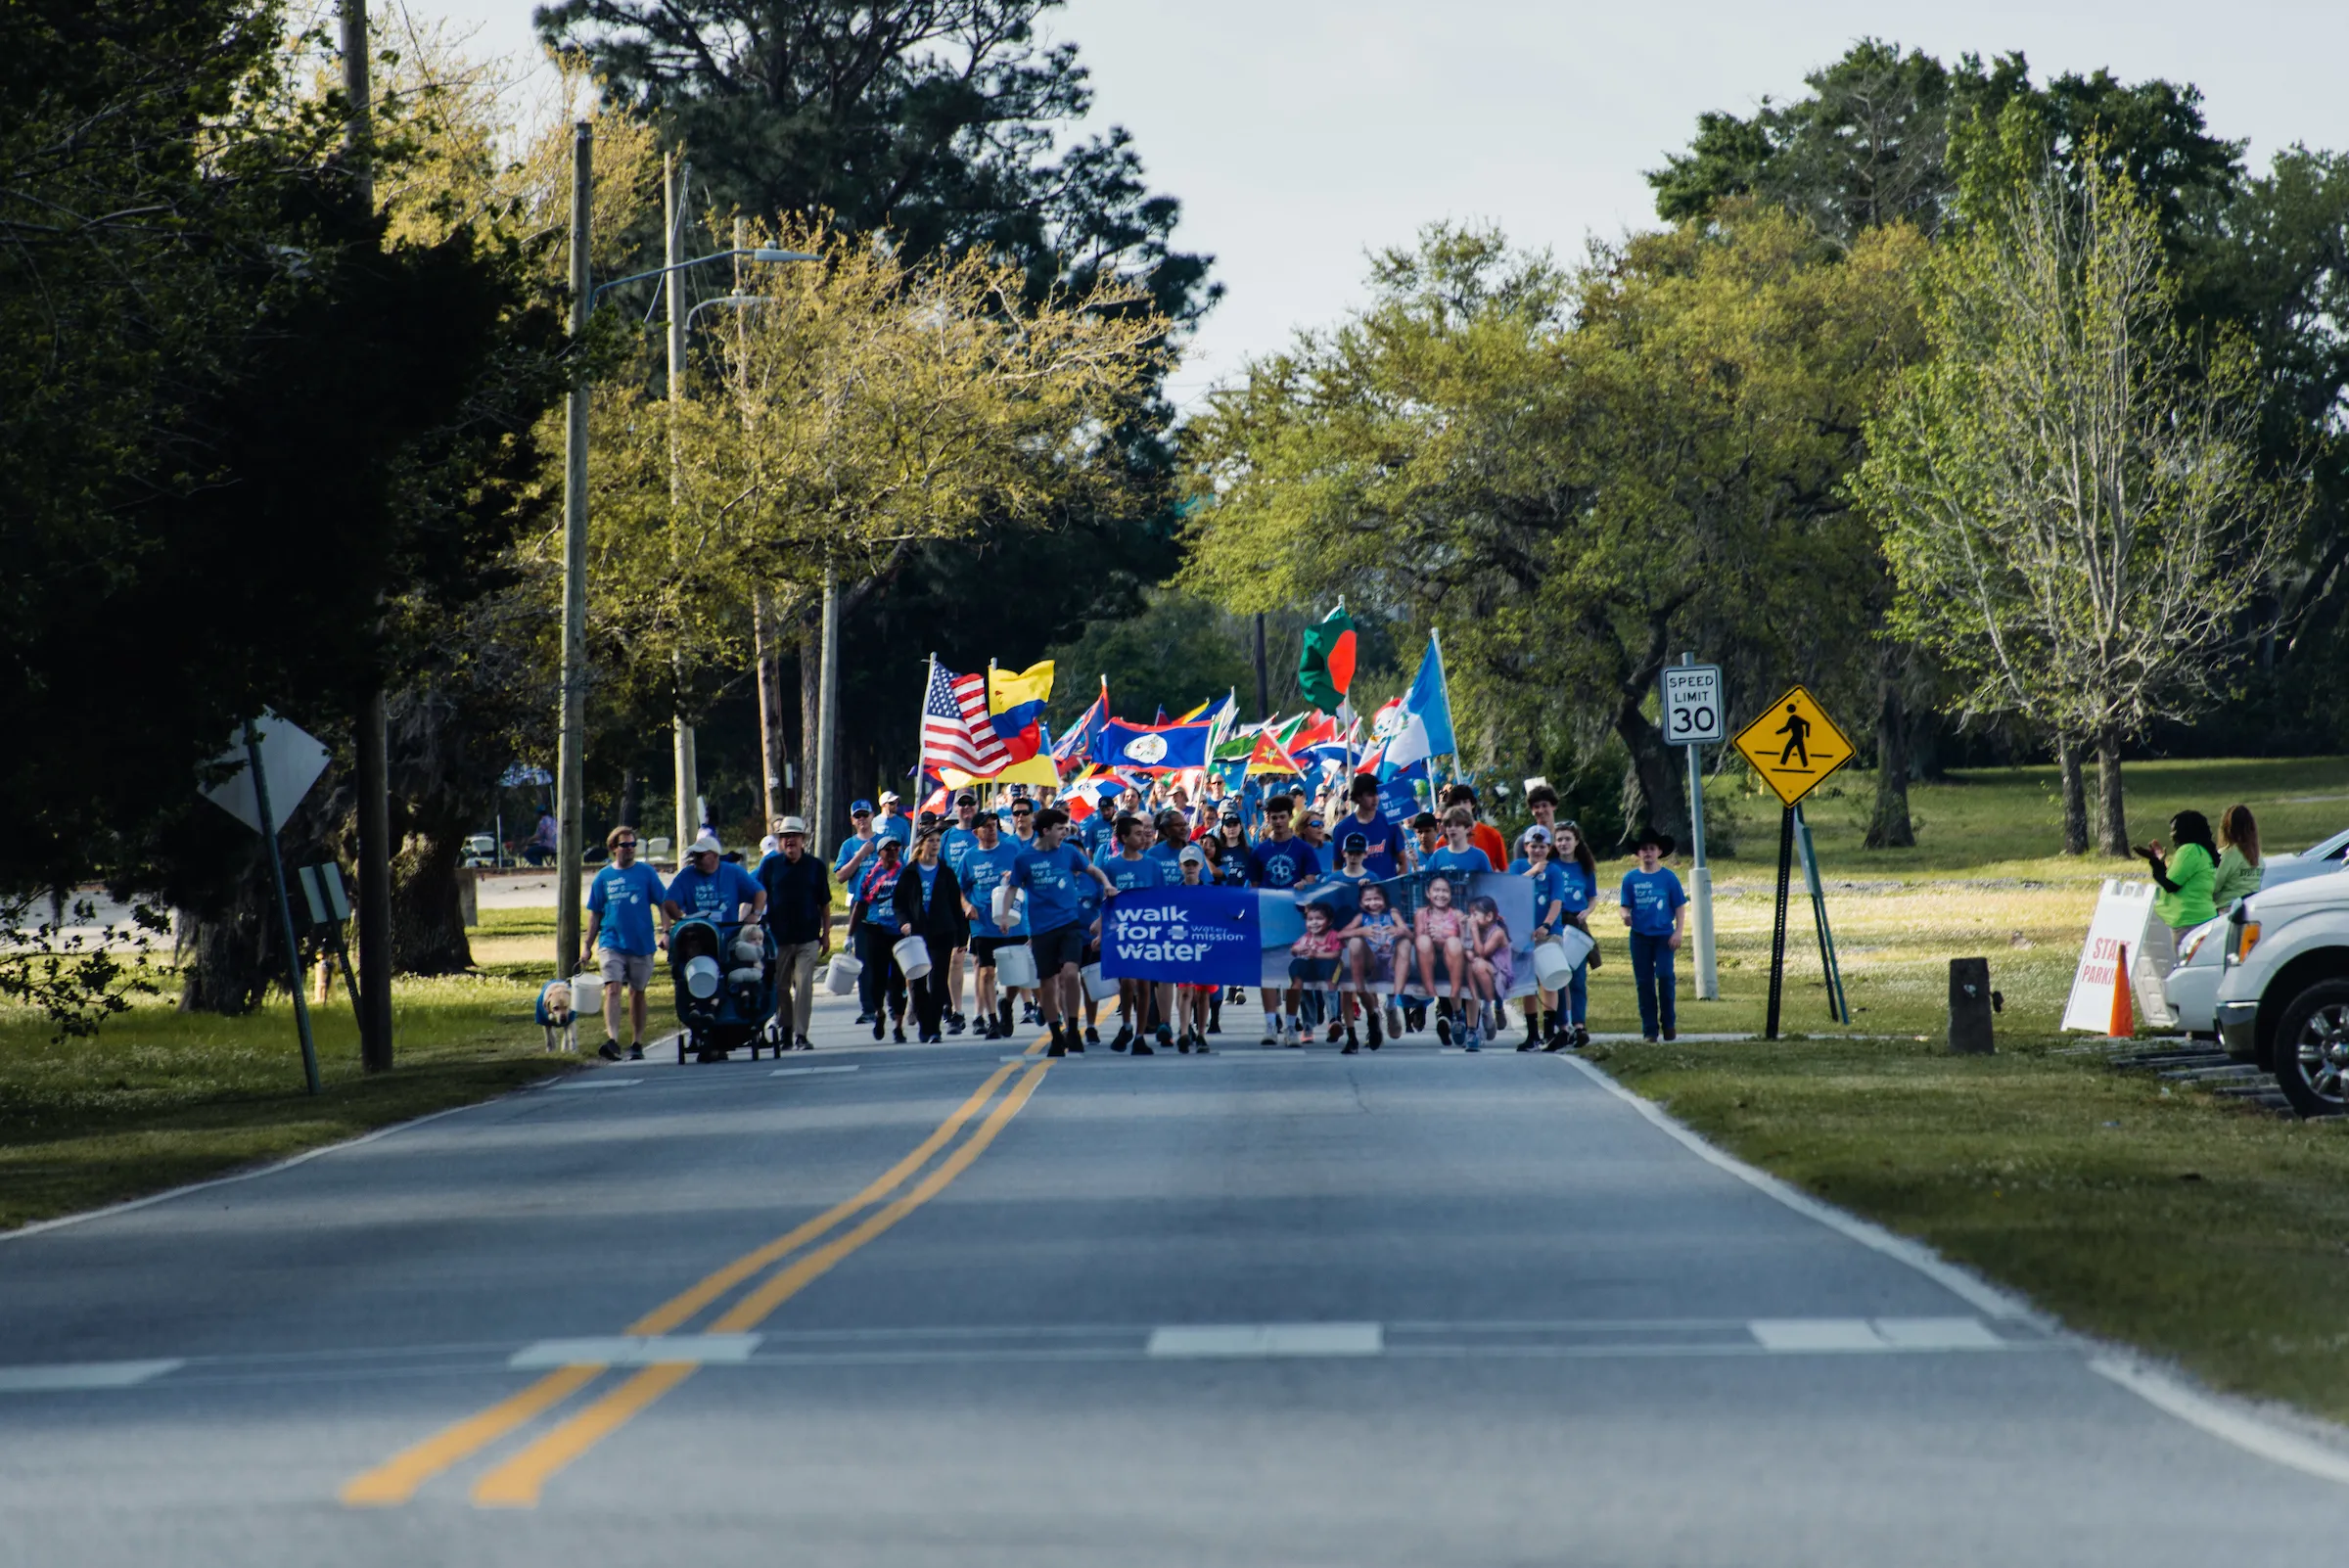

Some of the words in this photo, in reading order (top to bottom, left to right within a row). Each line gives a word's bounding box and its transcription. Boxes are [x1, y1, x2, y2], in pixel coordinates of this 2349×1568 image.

[1669, 675, 1714, 688] SPEED
[1675, 691, 1709, 703] LIMIT
[1673, 707, 1715, 733] 30
[973, 861, 994, 870] walk
[1030, 860, 1051, 870] walk
[974, 870, 987, 879] for
[607, 877, 626, 886] walk
[978, 876, 1000, 885] water
[1033, 876, 1057, 885] water
[607, 885, 620, 894] for
[1635, 889, 1646, 898] for
[608, 892, 631, 900] water
[1115, 905, 1189, 923] walk
[1117, 923, 1163, 942] for
[1191, 931, 1245, 942] mission
[1116, 941, 1210, 962] water
[2082, 964, 2115, 986] PARKI
